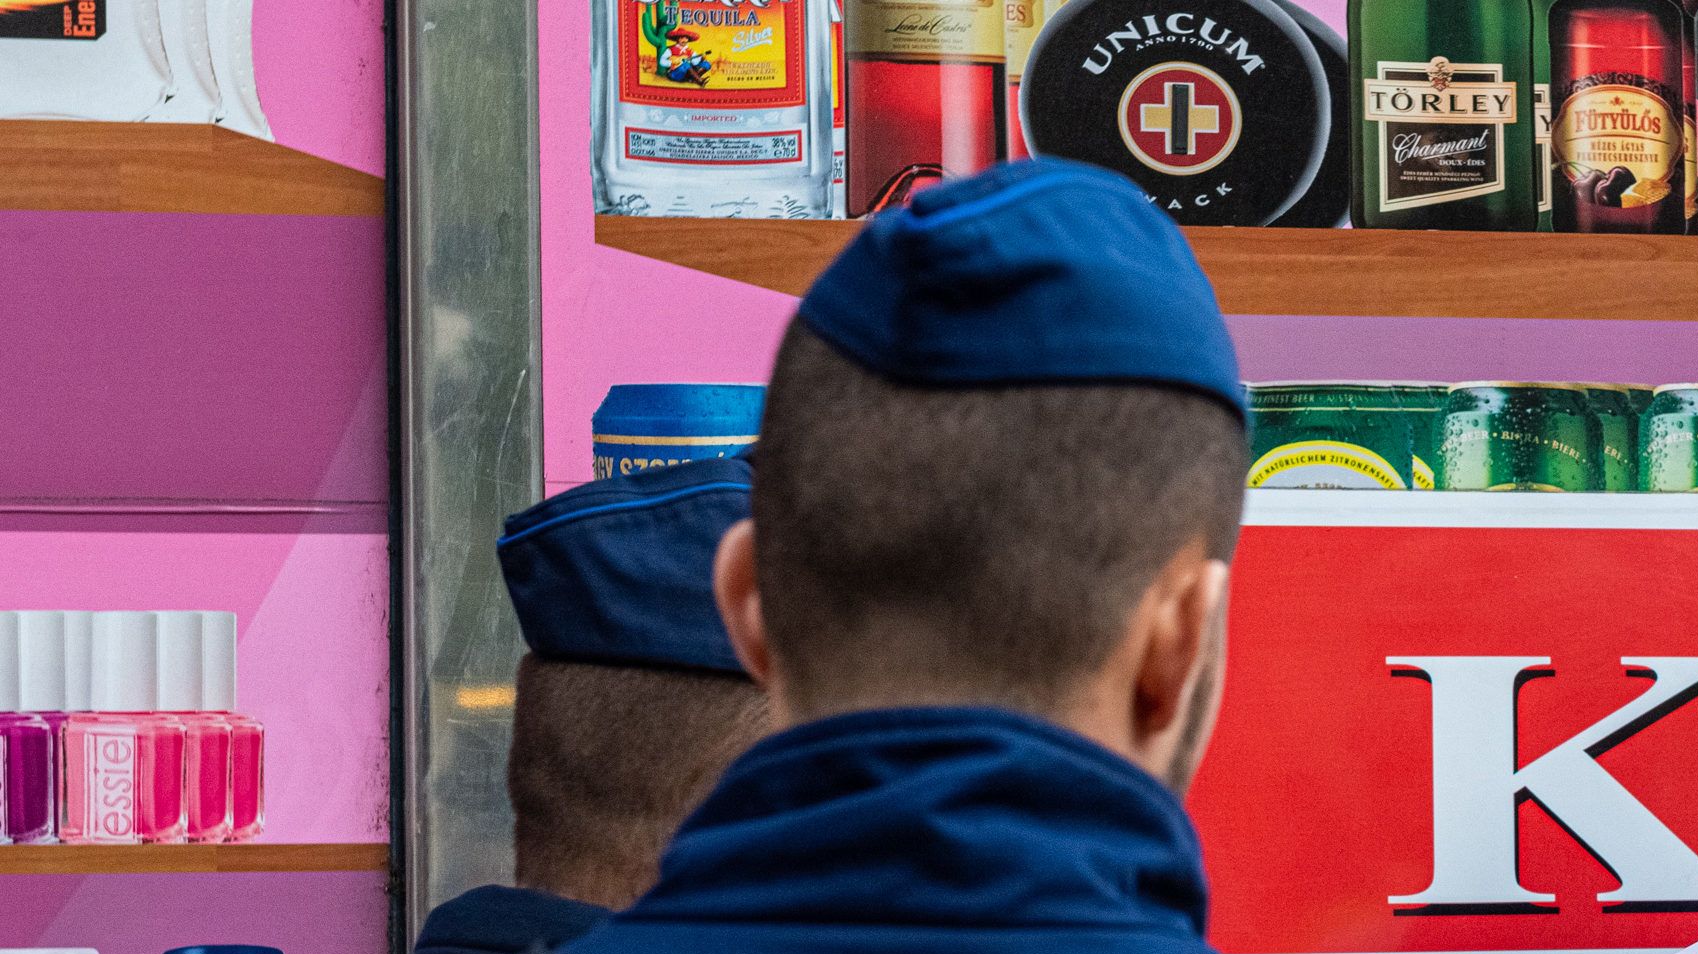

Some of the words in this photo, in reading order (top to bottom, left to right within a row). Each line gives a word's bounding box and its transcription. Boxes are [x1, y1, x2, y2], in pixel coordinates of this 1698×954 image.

[73, 0, 96, 37] Ene
[665, 6, 760, 27] TEQUILA
[732, 27, 773, 51] Silver
[1082, 12, 1262, 75] UNICUM
[1136, 36, 1176, 51] ANNO
[1371, 88, 1510, 114] TÖRLEY
[1392, 129, 1490, 166] Charmant
[1265, 455, 1327, 475] NATÜRLICHEM
[1330, 455, 1395, 488] ZITRONENSAFT
[103, 740, 132, 836] essie
